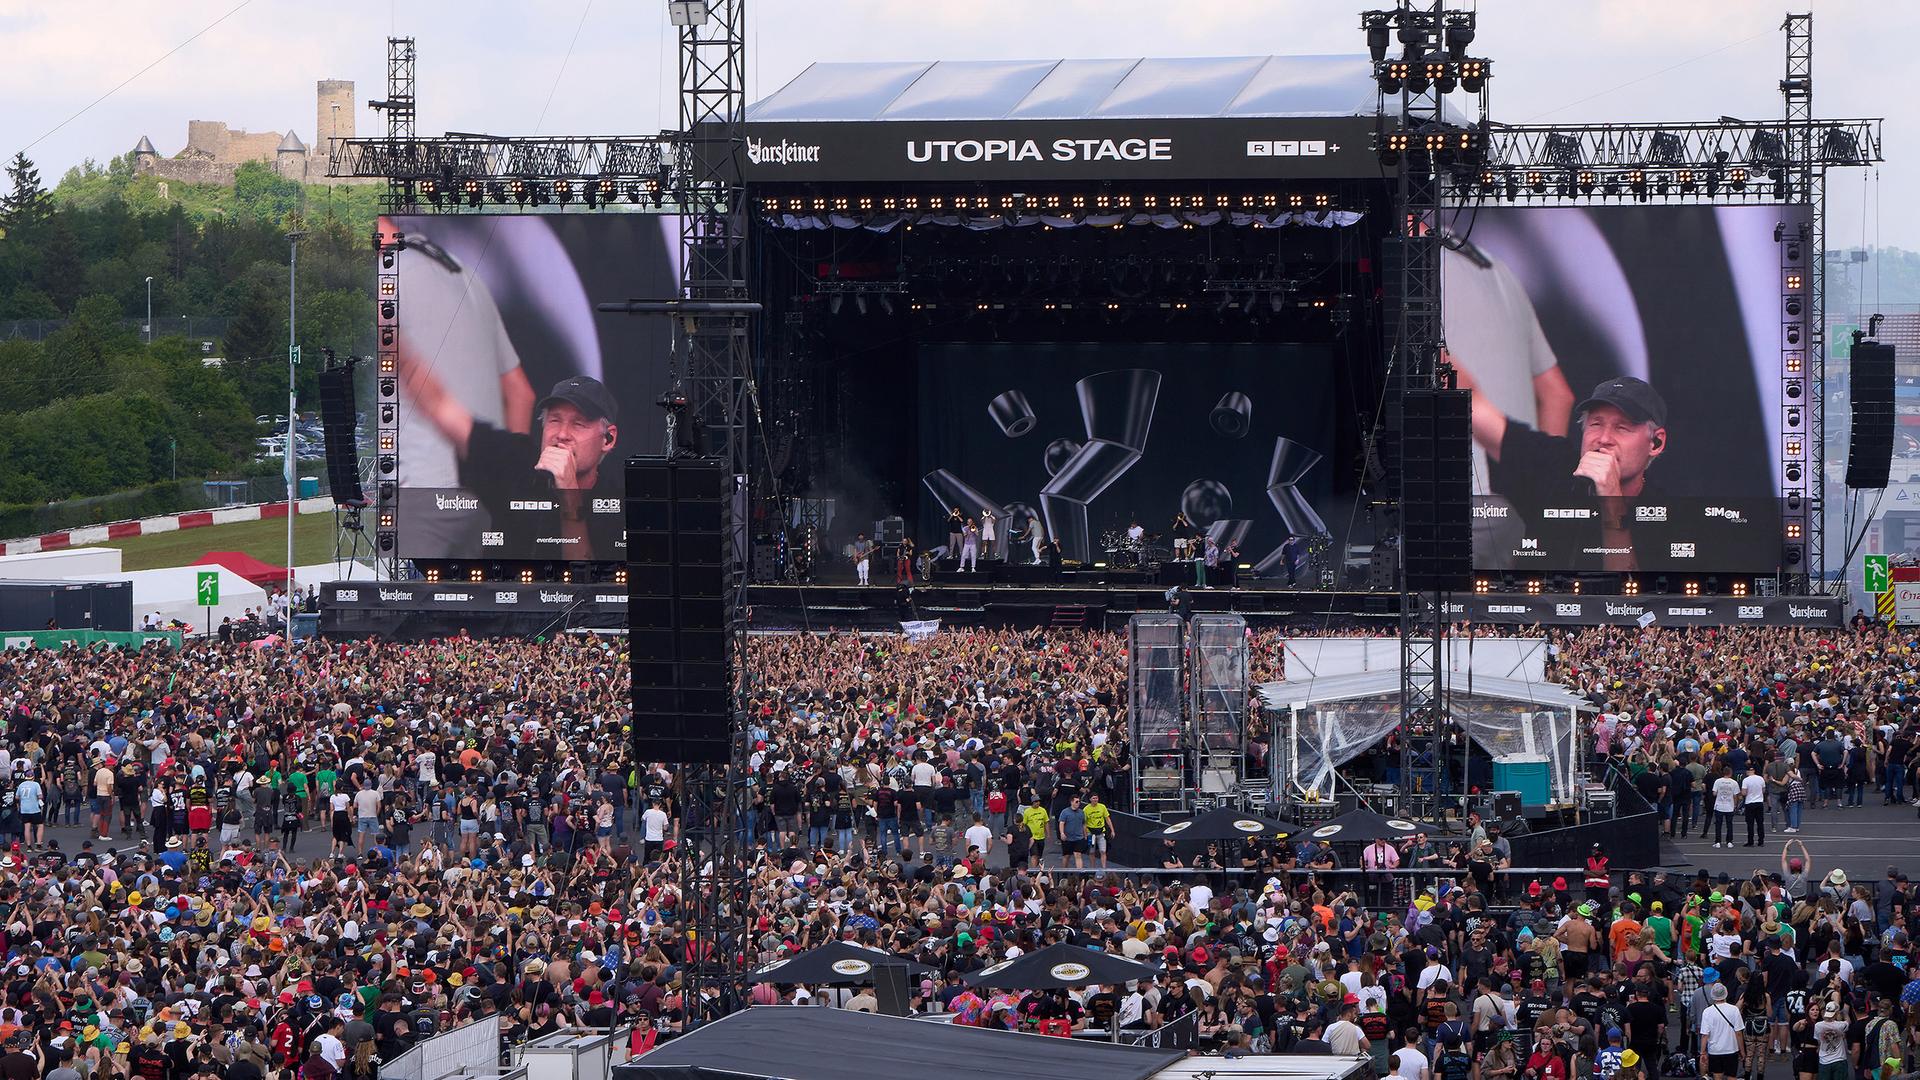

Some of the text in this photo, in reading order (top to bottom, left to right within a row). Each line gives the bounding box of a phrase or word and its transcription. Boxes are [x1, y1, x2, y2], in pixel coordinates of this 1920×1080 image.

[906, 138, 1173, 163] UTOPIA STAGE
[1472, 502, 1508, 519] rsteiner
[595, 594, 629, 602] RTL
